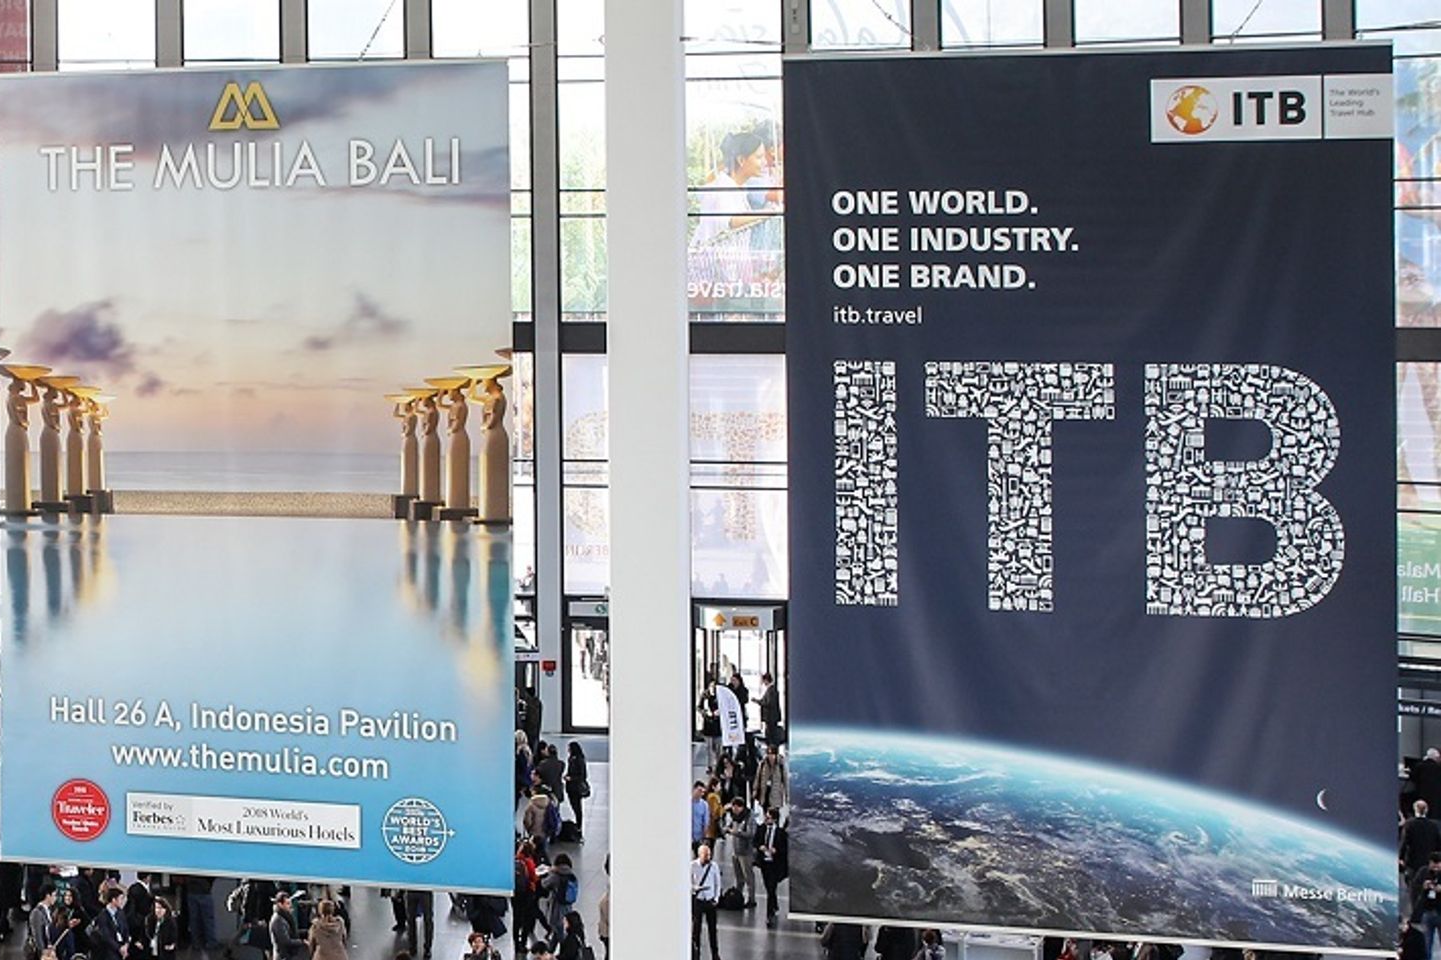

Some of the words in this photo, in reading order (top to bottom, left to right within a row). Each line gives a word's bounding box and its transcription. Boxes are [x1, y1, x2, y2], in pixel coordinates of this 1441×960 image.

[1232, 90, 1307, 127] ITB
[40, 144, 135, 190] THE
[154, 140, 327, 188] MULIA
[349, 137, 460, 185] BALI
[831, 190, 899, 215] ONE
[908, 190, 1039, 215] WORLD.
[832, 227, 900, 252] ONE
[910, 227, 1079, 252] INDUSTRY.
[832, 264, 900, 289] ONE
[910, 264, 1037, 289] BRAND.
[833, 305, 923, 325] itb.travel
[833, 359, 1346, 619] ITB
[51, 697, 106, 724] Hall
[114, 700, 146, 726] 26
[154, 702, 181, 732] A,
[192, 703, 329, 735] Indonesia
[340, 709, 456, 742] Pavilion
[112, 743, 389, 780] www.themulia.com
[133, 811, 173, 825] Forbes
[242, 807, 268, 819] 2018
[270, 808, 309, 821] World's
[390, 816, 440, 827] WORLD'S
[197, 818, 233, 834] Most
[237, 820, 306, 839] Luxurious
[309, 825, 355, 842] Hotels
[391, 835, 439, 847] AWARDS
[403, 827, 428, 837] BEST
[1284, 884, 1333, 901] Messe
[1337, 887, 1384, 904] Berlin
